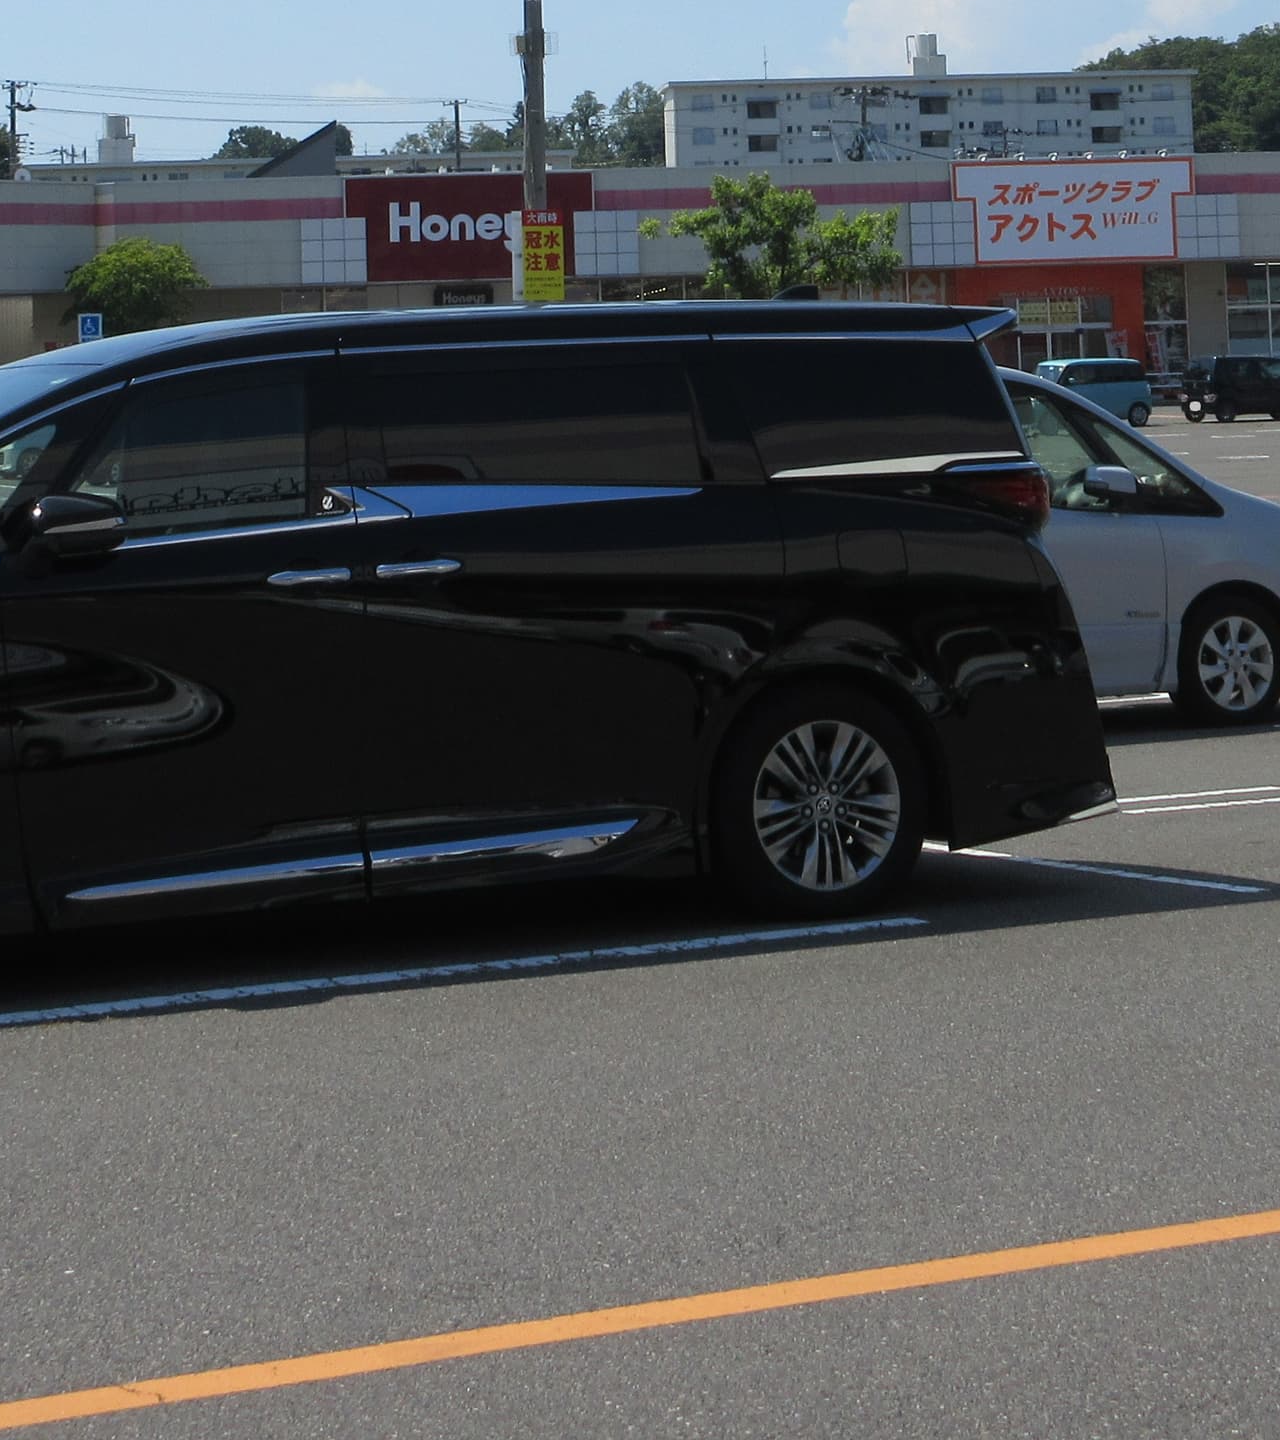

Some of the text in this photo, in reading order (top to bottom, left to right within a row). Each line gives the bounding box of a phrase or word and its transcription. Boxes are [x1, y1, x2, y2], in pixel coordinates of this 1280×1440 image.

[988, 178, 1160, 206] スポーツクラブ
[527, 212, 558, 224] 大雨時
[987, 212, 1097, 244] アクトス
[525, 231, 560, 249] 冠水
[525, 253, 560, 271] 注意
[442, 291, 487, 305] Honeys
